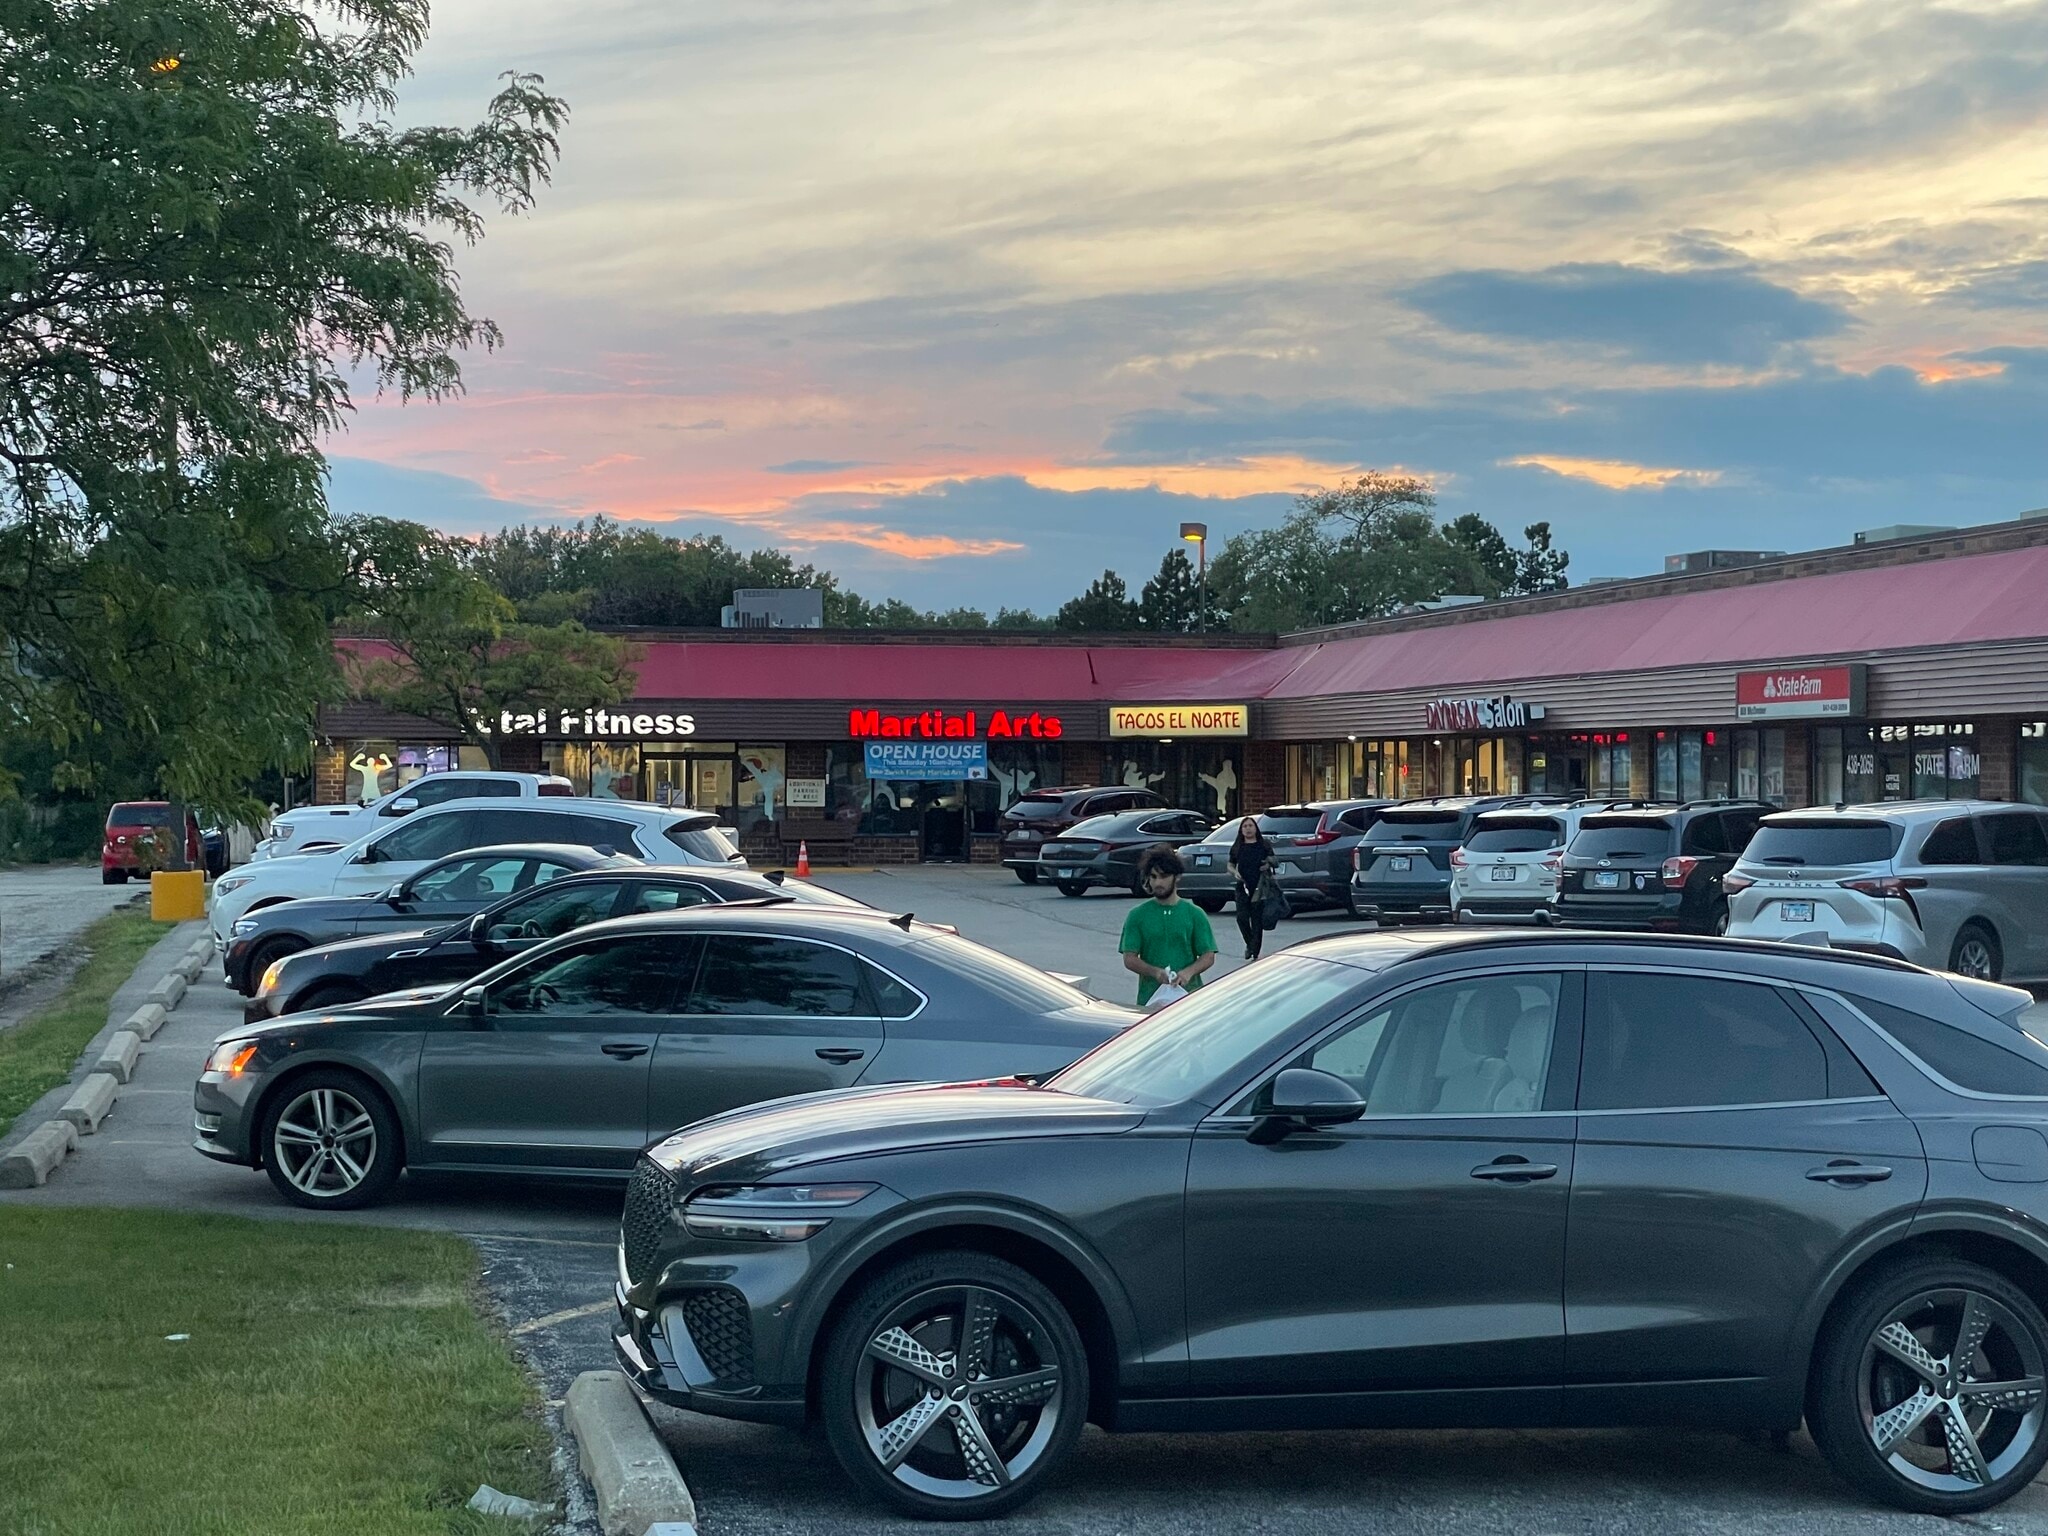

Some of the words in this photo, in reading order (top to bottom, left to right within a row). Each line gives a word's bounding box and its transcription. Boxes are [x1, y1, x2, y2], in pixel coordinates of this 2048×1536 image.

[560, 708, 696, 735] Fitness
[849, 709, 976, 737] Martial
[987, 710, 1063, 738] Arts
[1116, 713, 1165, 729] TACOS
[1169, 713, 1187, 729] EL
[1191, 712, 1241, 729] NORTE
[1484, 696, 1525, 729] Salon
[869, 745, 917, 759] OPEN
[922, 745, 982, 759] HOUSE
[1915, 754, 1944, 775] STATE
